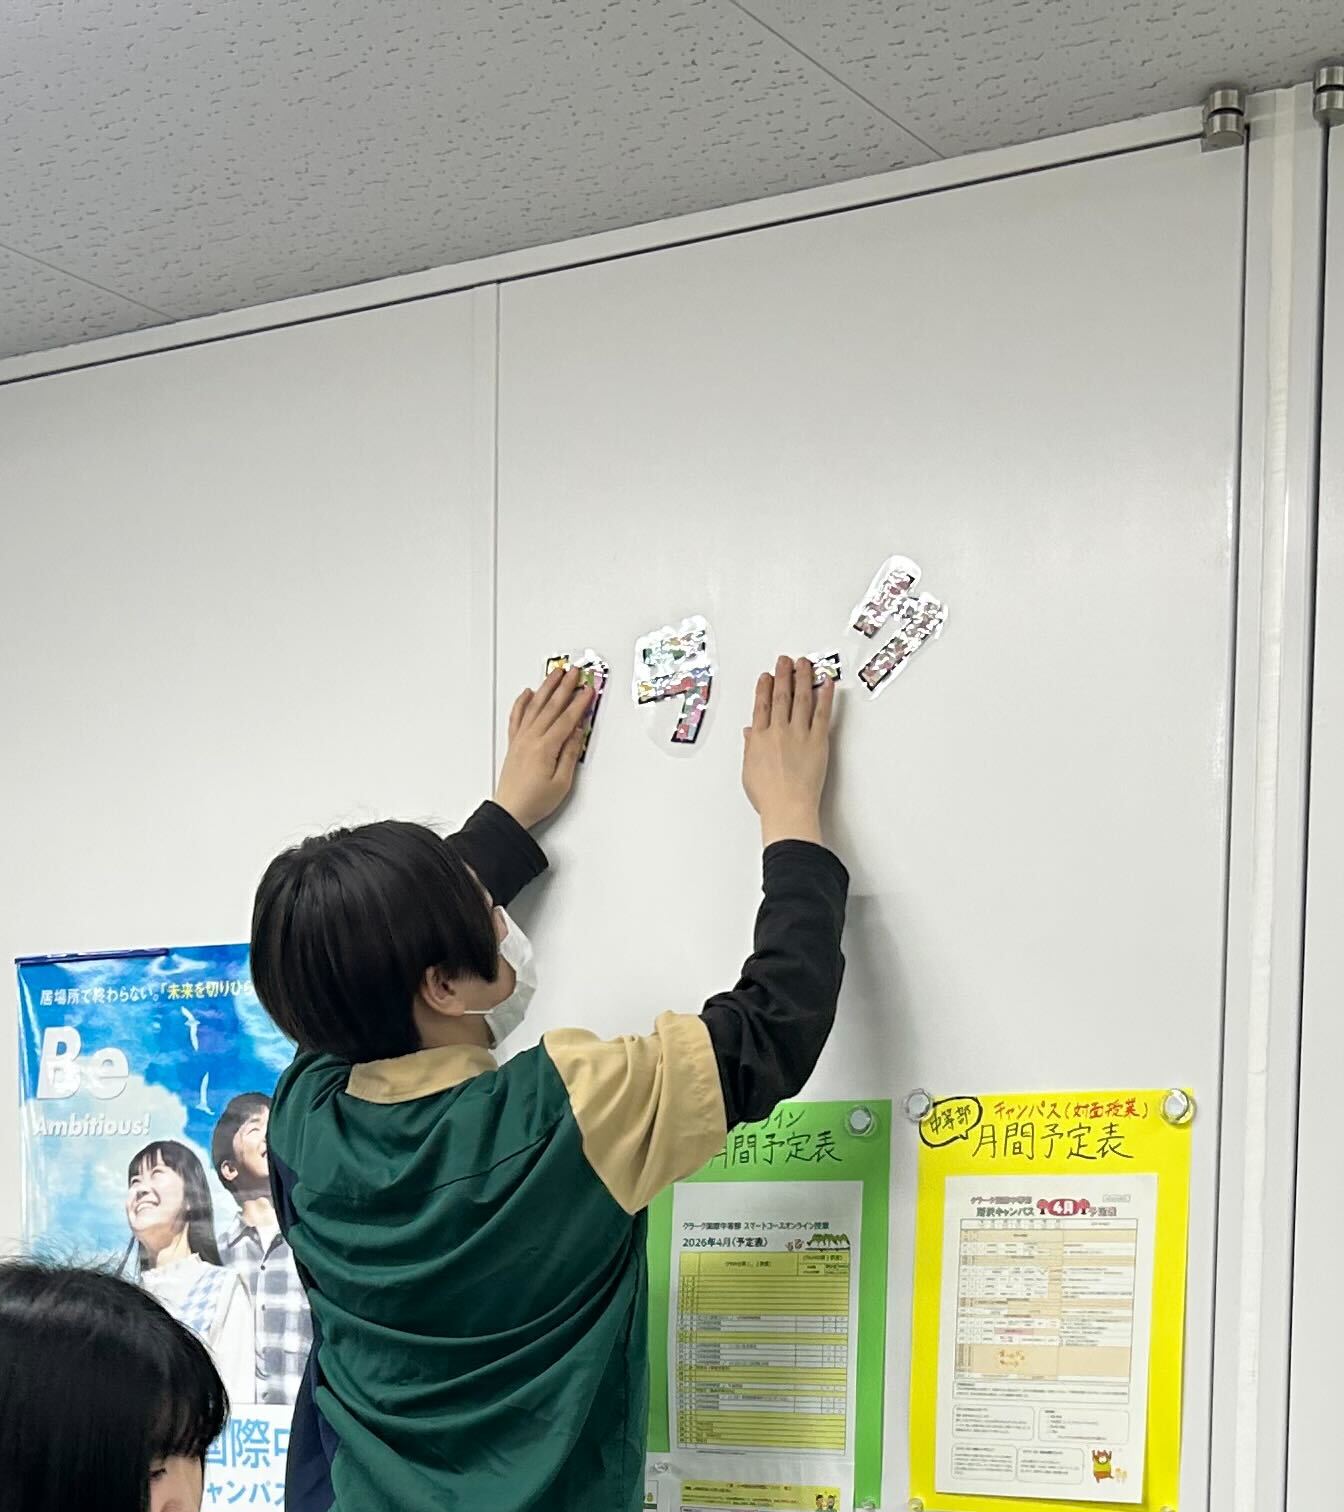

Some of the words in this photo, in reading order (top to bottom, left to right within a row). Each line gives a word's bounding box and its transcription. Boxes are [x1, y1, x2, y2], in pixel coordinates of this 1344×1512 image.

[37, 1026, 129, 1100] Be
[33, 1113, 152, 1137] Ambitious!
[928, 1104, 971, 1135] 中等部
[972, 1122, 1135, 1161] 月間予定表
